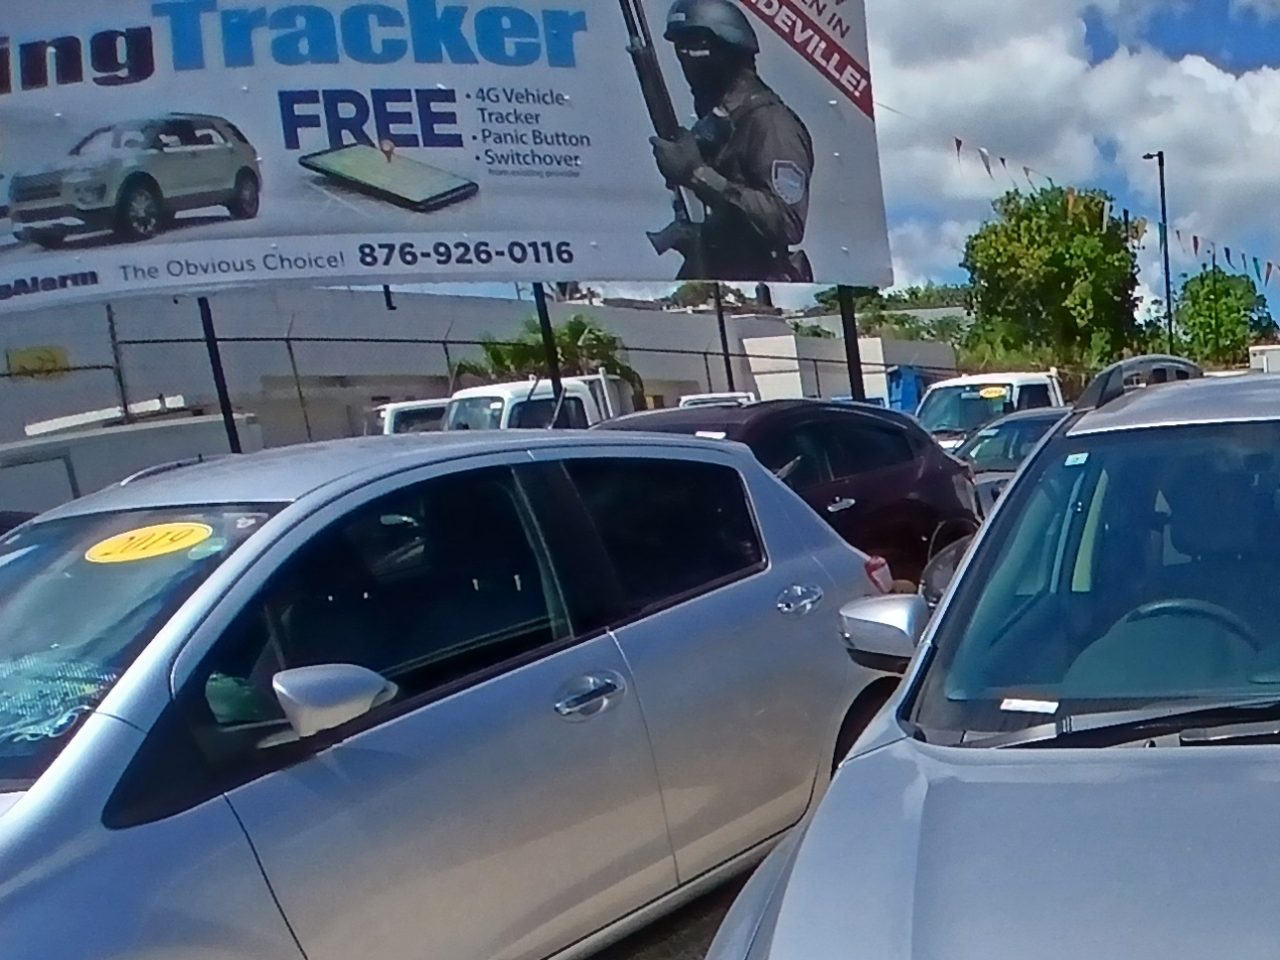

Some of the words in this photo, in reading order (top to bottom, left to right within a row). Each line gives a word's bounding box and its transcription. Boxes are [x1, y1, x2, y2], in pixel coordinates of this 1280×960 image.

[827, 12, 850, 39] IN
[751, 0, 868, 98] DEVILLE!
[475, 87, 500, 104] 4G
[502, 88, 566, 106] Vehicle
[277, 88, 464, 151] FREE
[476, 108, 541, 124] Tracker
[481, 128, 529, 145] Panic
[532, 129, 591, 147] Button
[484, 149, 581, 168] Switchover
[119, 264, 159, 282] The
[166, 256, 256, 277] Obvious
[262, 251, 345, 271] Choice!
[358, 240, 574, 267] 876-926-0116
